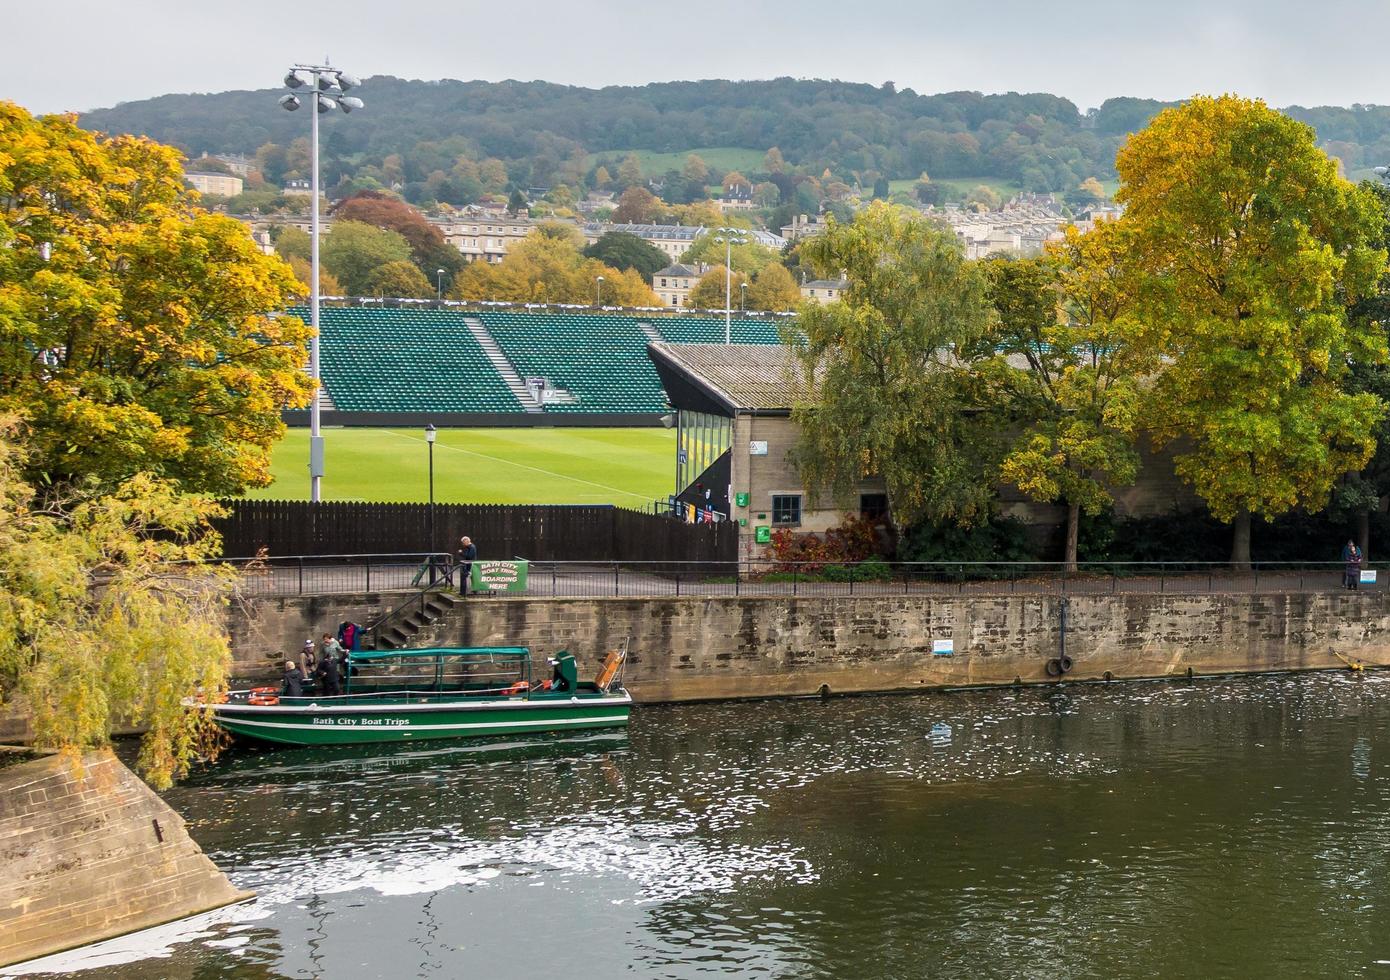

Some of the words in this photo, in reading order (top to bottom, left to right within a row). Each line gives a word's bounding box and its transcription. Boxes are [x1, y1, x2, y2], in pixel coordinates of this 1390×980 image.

[501, 568, 518, 576] TRIPS
[313, 717, 334, 725] Bath
[337, 717, 357, 726] City
[385, 718, 410, 726] Trips
